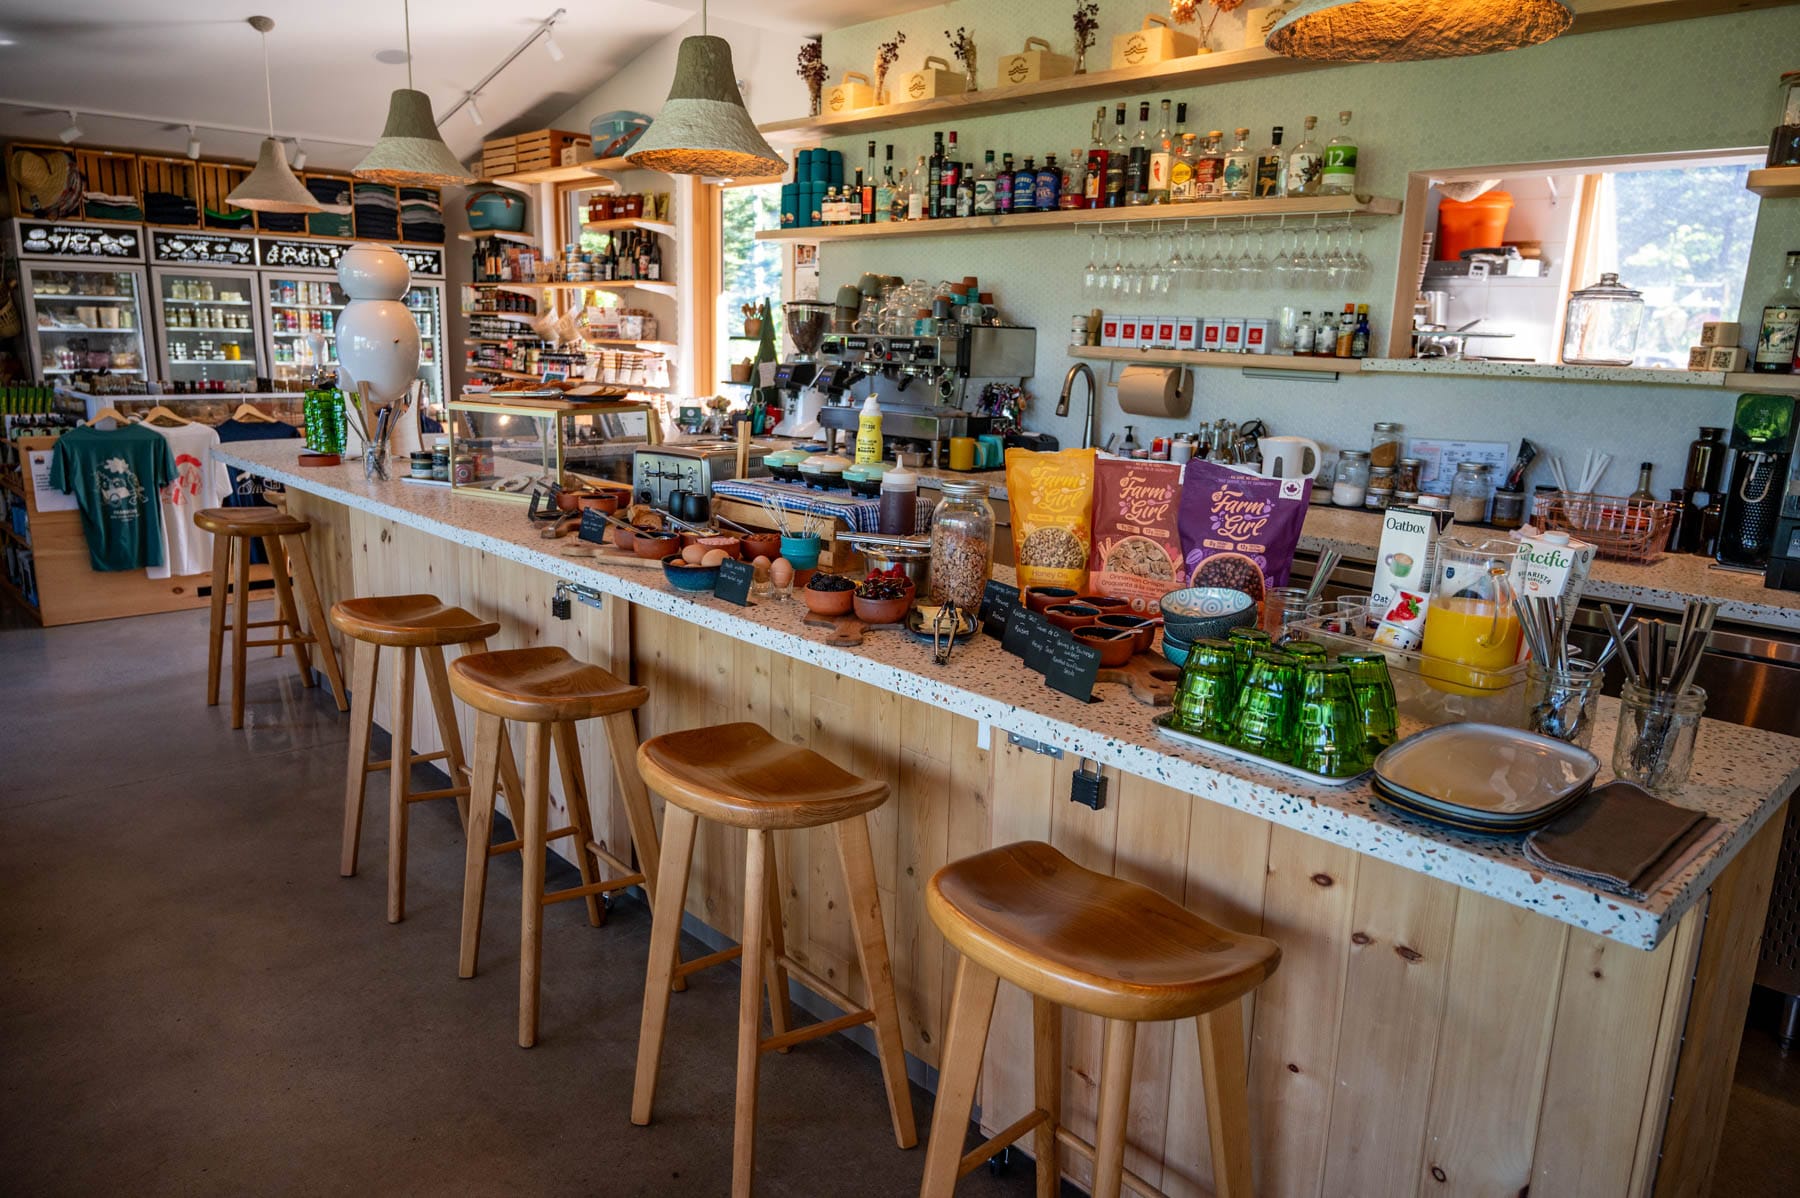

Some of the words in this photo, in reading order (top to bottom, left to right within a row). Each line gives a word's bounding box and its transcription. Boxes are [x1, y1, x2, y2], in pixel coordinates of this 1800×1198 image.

[1328, 151, 1344, 166] 12
[1031, 466, 1080, 489] Farm
[1120, 477, 1165, 501] Farm
[1038, 488, 1083, 513] Girl
[1126, 499, 1169, 525] Girl
[1211, 490, 1265, 515] Farm
[1217, 514, 1268, 541] Girl
[1386, 517, 1425, 534] Oatbox
[1109, 574, 1142, 584] Cinnamon
[1373, 593, 1389, 604] Oat
